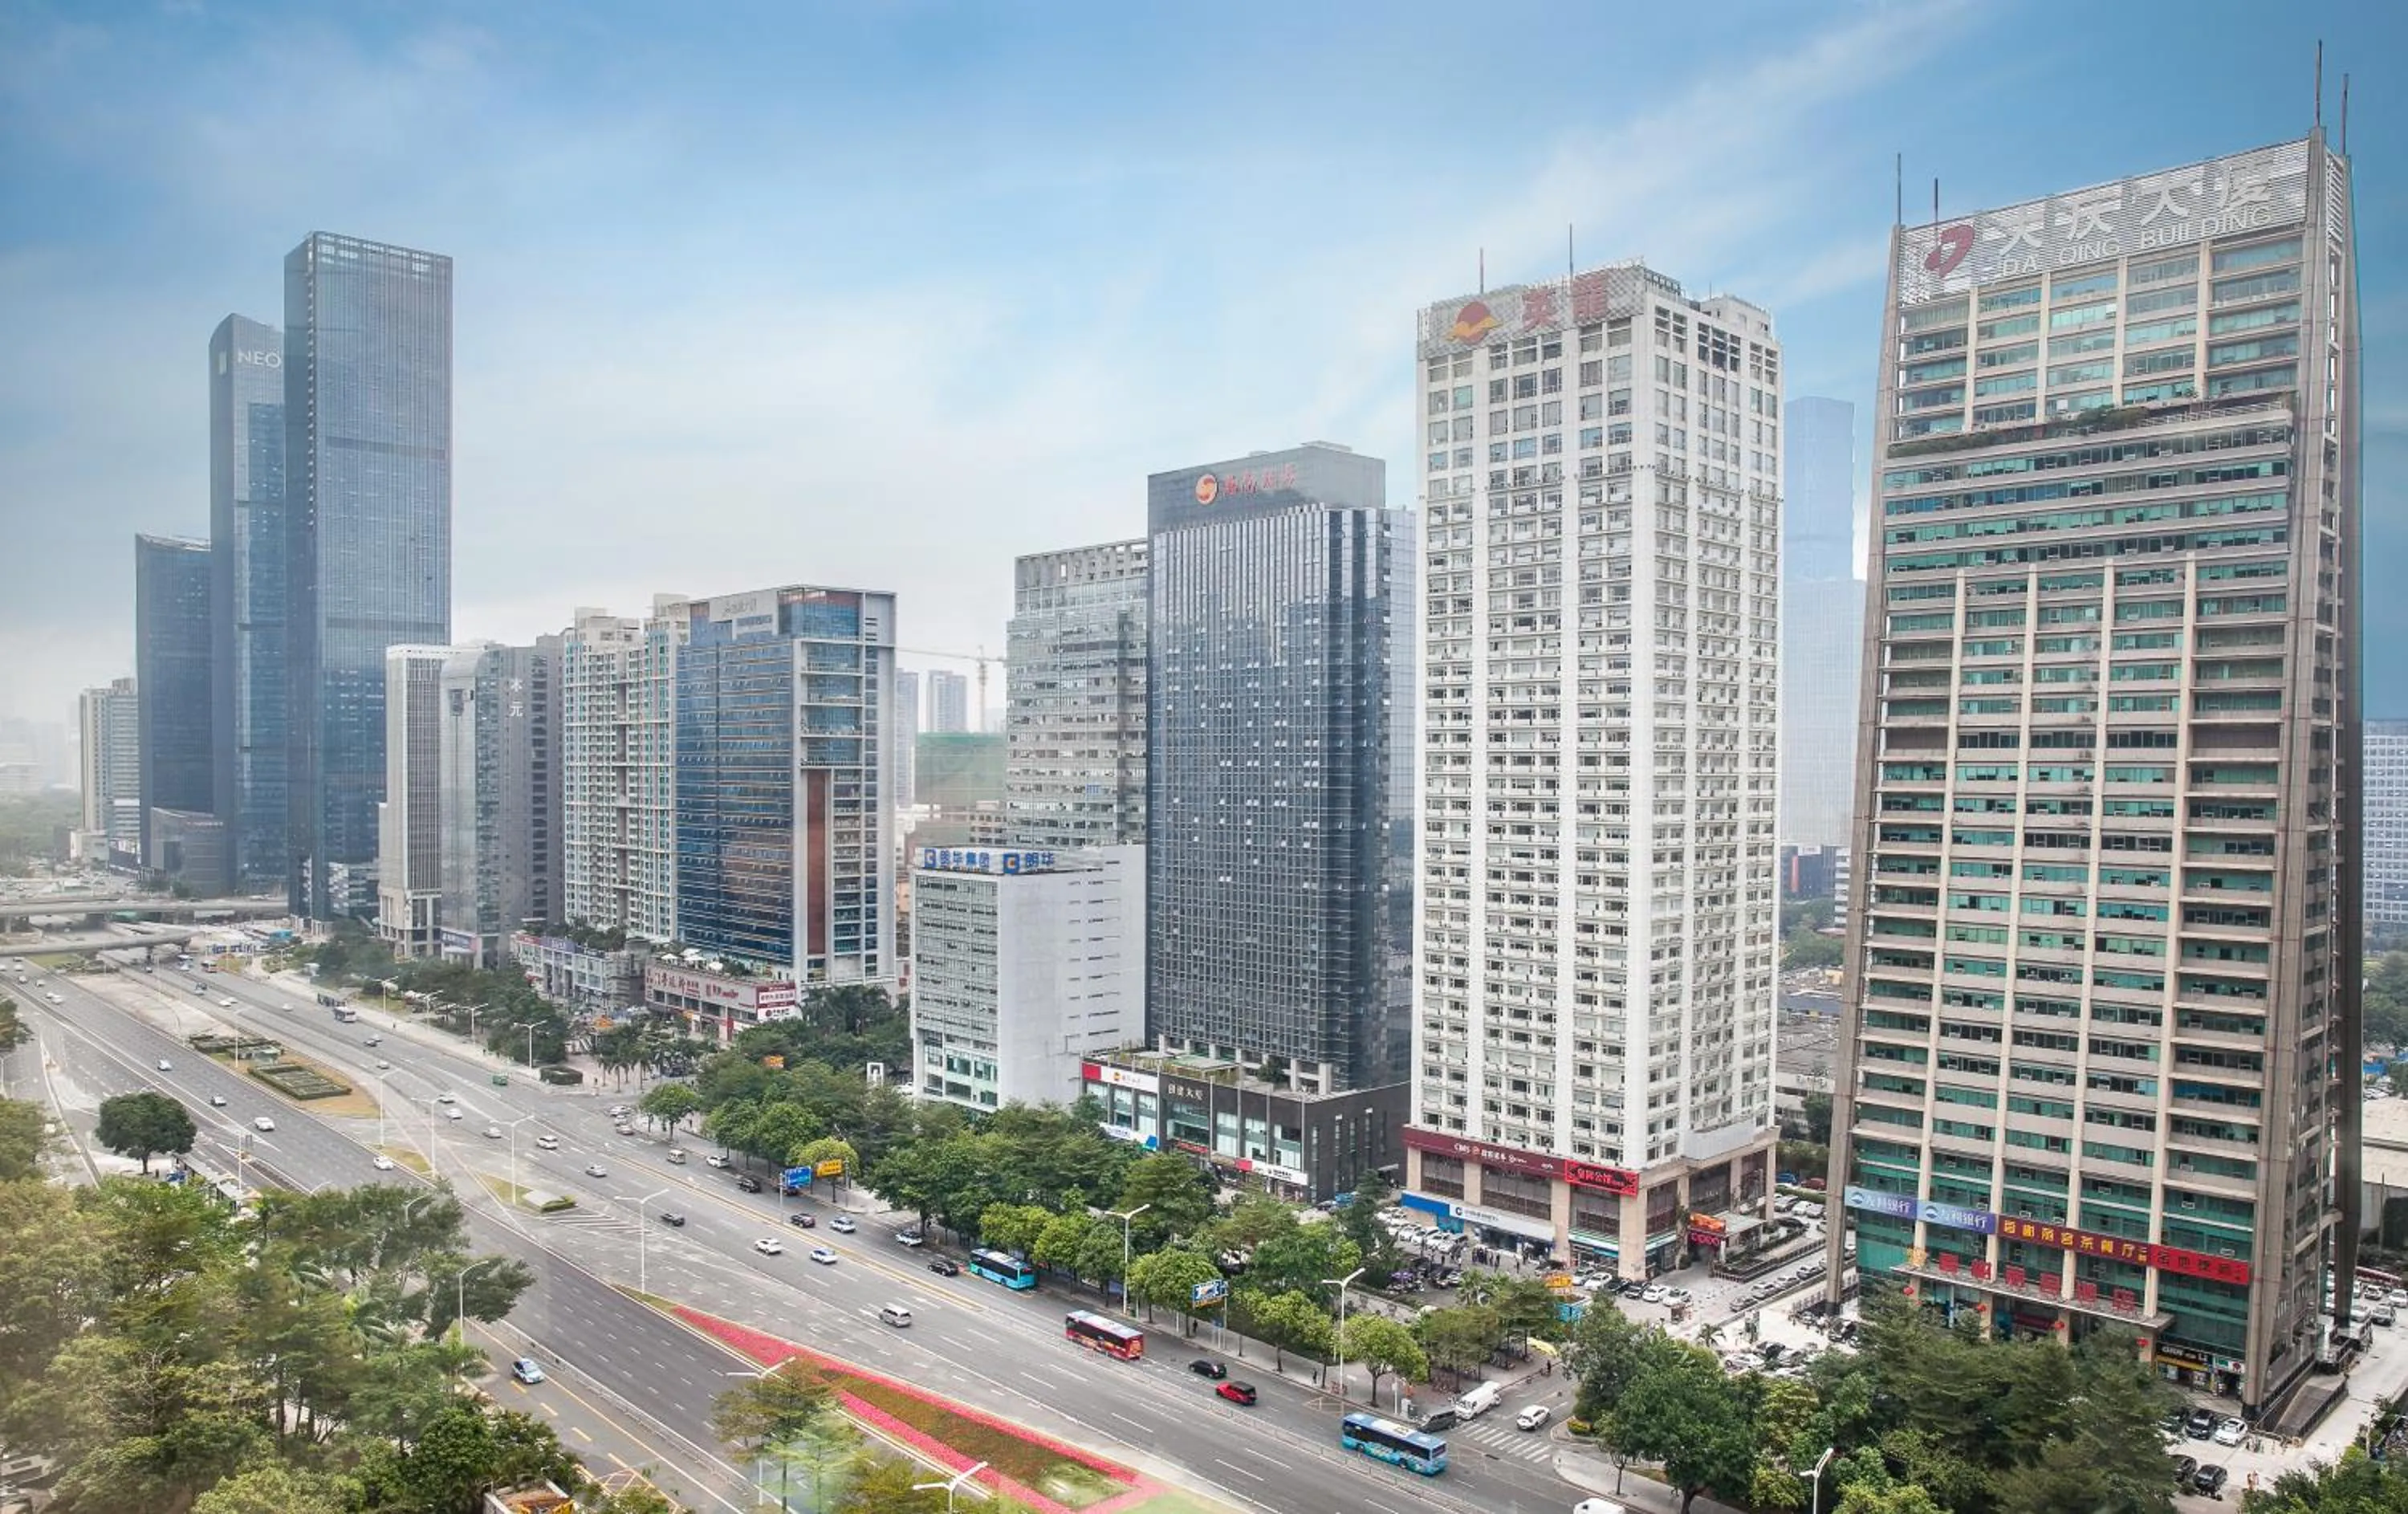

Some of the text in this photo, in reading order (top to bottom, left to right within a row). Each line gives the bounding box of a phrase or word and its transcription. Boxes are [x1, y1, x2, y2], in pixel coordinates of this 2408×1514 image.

[2003, 205, 2272, 277] DA QING BUILDING
